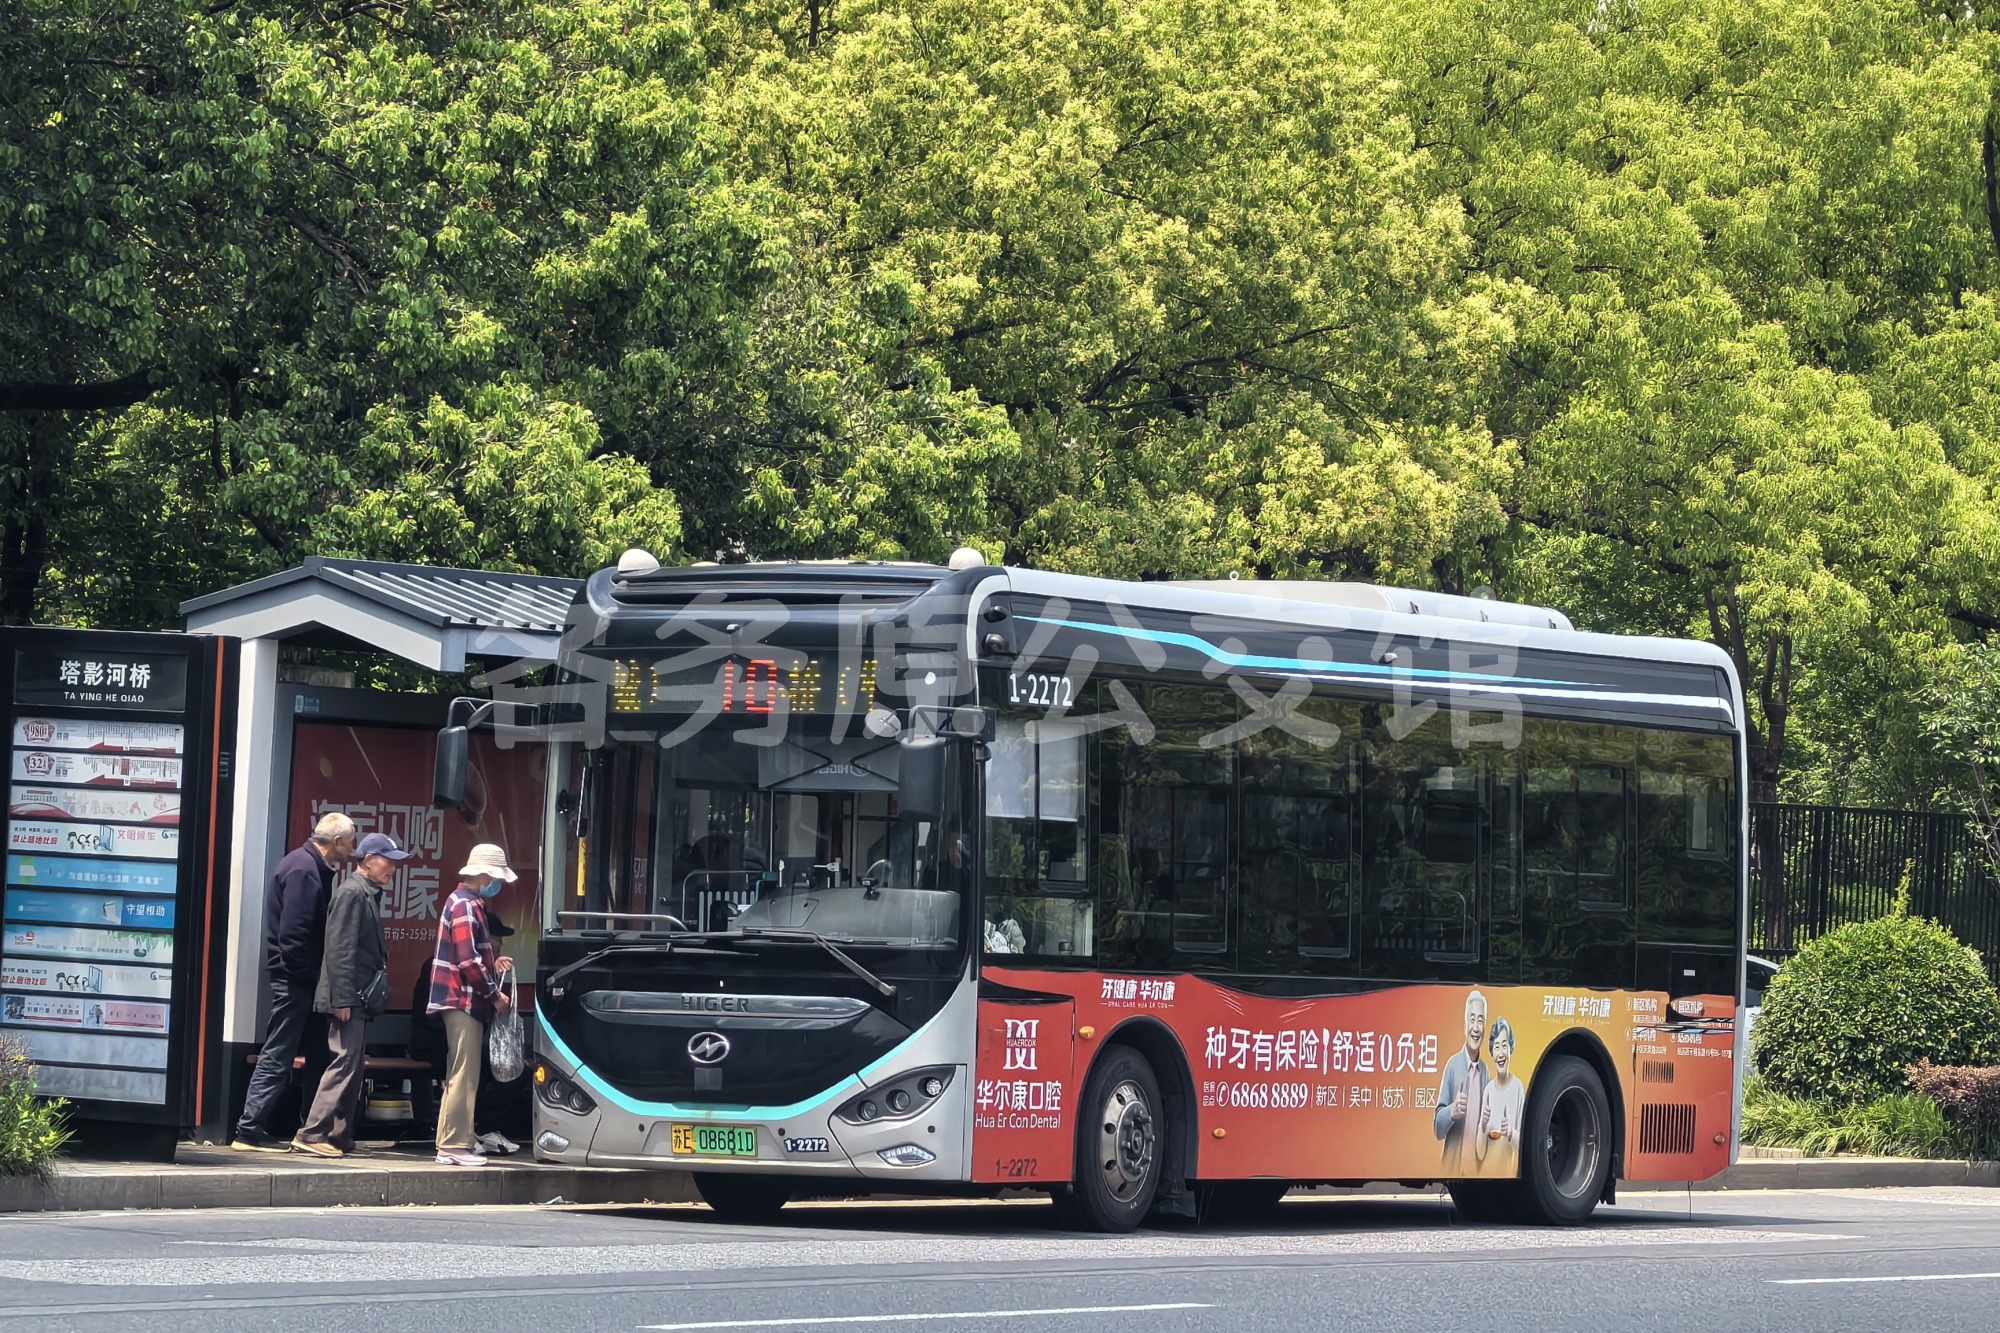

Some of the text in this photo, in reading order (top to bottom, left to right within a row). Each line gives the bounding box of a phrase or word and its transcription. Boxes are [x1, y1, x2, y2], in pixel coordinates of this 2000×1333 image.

[59, 660, 151, 689] 塔影河桥
[723, 659, 778, 711] 10
[64, 691, 144, 703] TA YING HE QIAO
[1009, 673, 1073, 707] 1-2272
[126, 903, 166, 917] 守望相助
[1101, 978, 1176, 1001] 牙健康 华尔康
[681, 996, 749, 1013] HIGER
[1578, 996, 1611, 1018] 华尔康
[976, 1079, 1062, 1111] 华尔康口腔
[1315, 1084, 1437, 1109] 新区 吴中 姑苏 园区
[975, 1112, 1061, 1129] Hua Er Con Dental
[995, 1158, 1038, 1178] 1-2272
